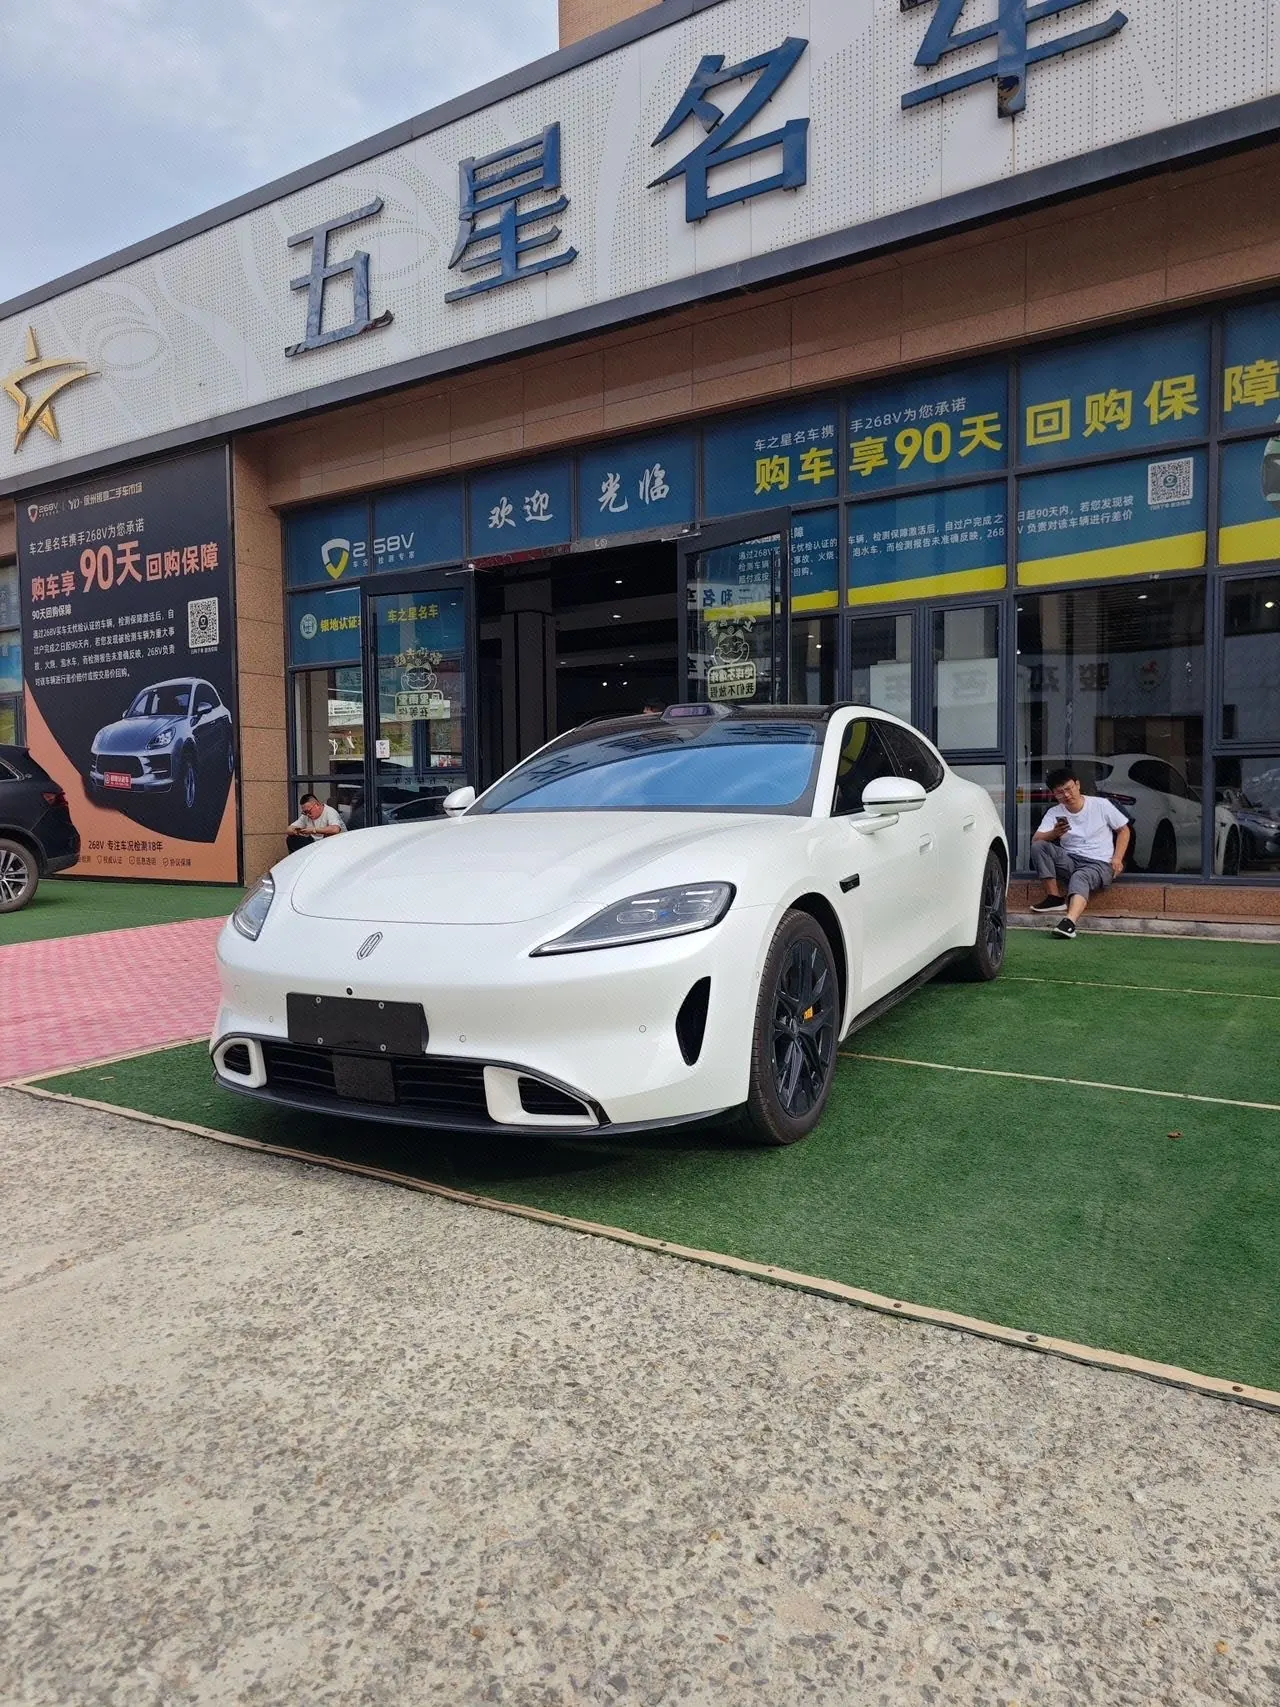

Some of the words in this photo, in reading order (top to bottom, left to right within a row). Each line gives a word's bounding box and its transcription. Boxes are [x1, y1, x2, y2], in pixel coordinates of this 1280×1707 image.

[29, 518, 145, 555] 车之星名车携手268V为您承诺
[387, 604, 438, 623] 车之星名车
[88, 840, 104, 850] 268V
